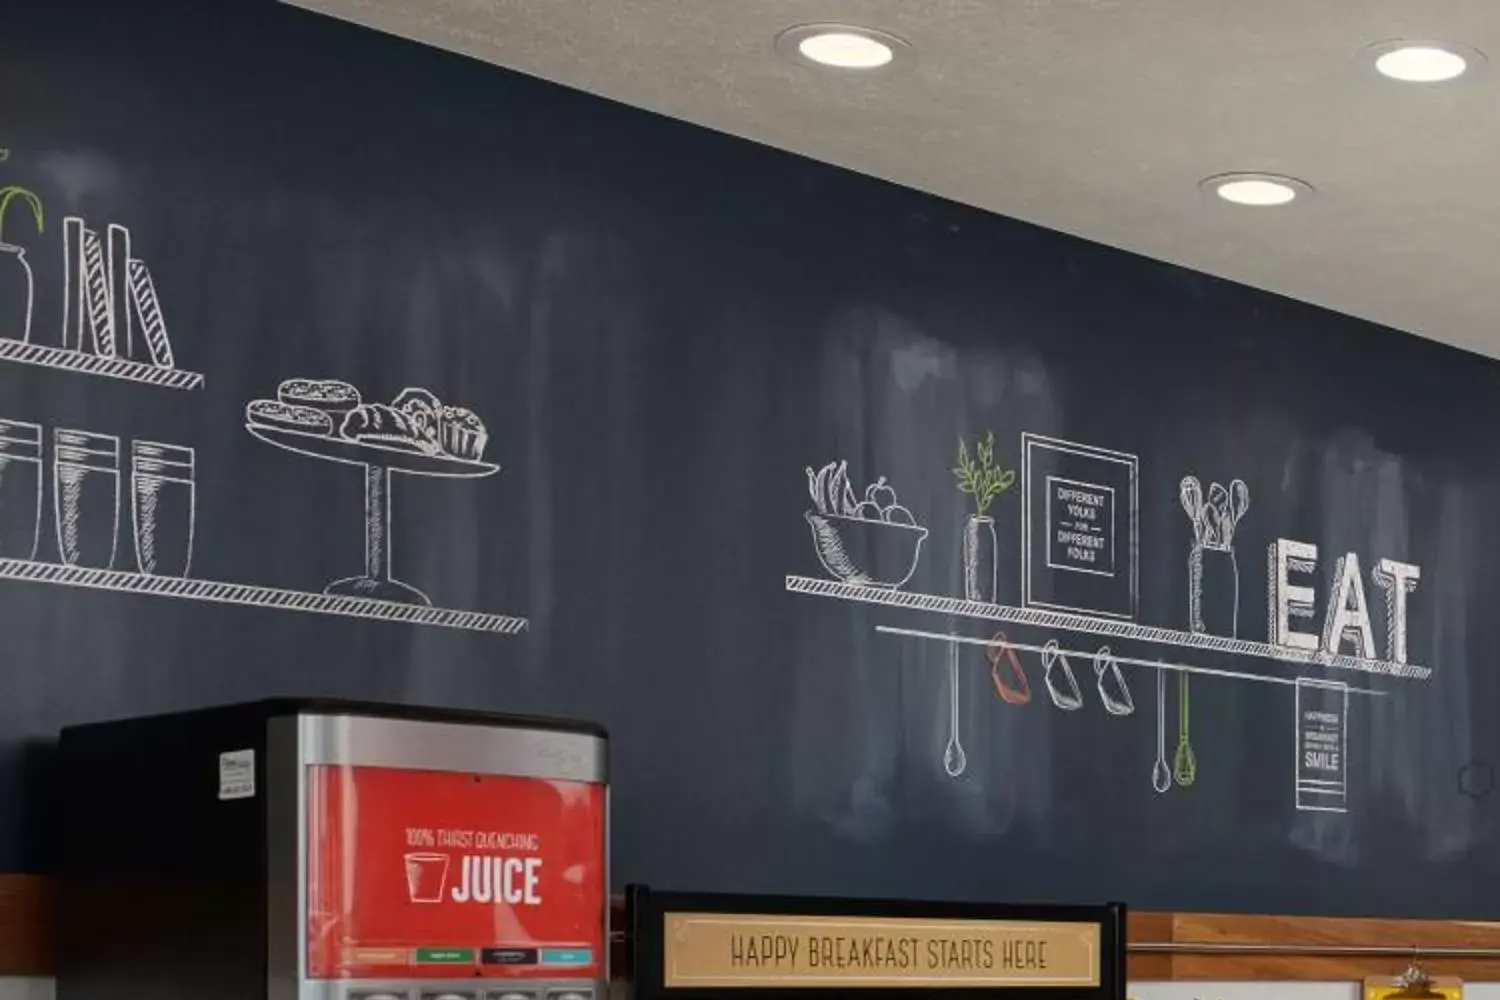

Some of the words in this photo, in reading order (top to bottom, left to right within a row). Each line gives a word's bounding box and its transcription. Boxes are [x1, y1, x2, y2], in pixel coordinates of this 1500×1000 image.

[1057, 487, 1105, 507] DIFFERENT
[1057, 530, 1105, 549] DIFFERENT
[1268, 537, 1421, 665] EAT
[1305, 751, 1339, 771] SMILE
[405, 827, 435, 847] 100%
[437, 828, 474, 848] THIRST
[475, 831, 540, 851] QUENCHING
[451, 855, 542, 905] JUICE
[731, 935, 799, 969] HAPPY
[808, 936, 920, 969] BREAKFAST
[927, 938, 994, 970] STARTS
[1002, 940, 1048, 970] HERE
